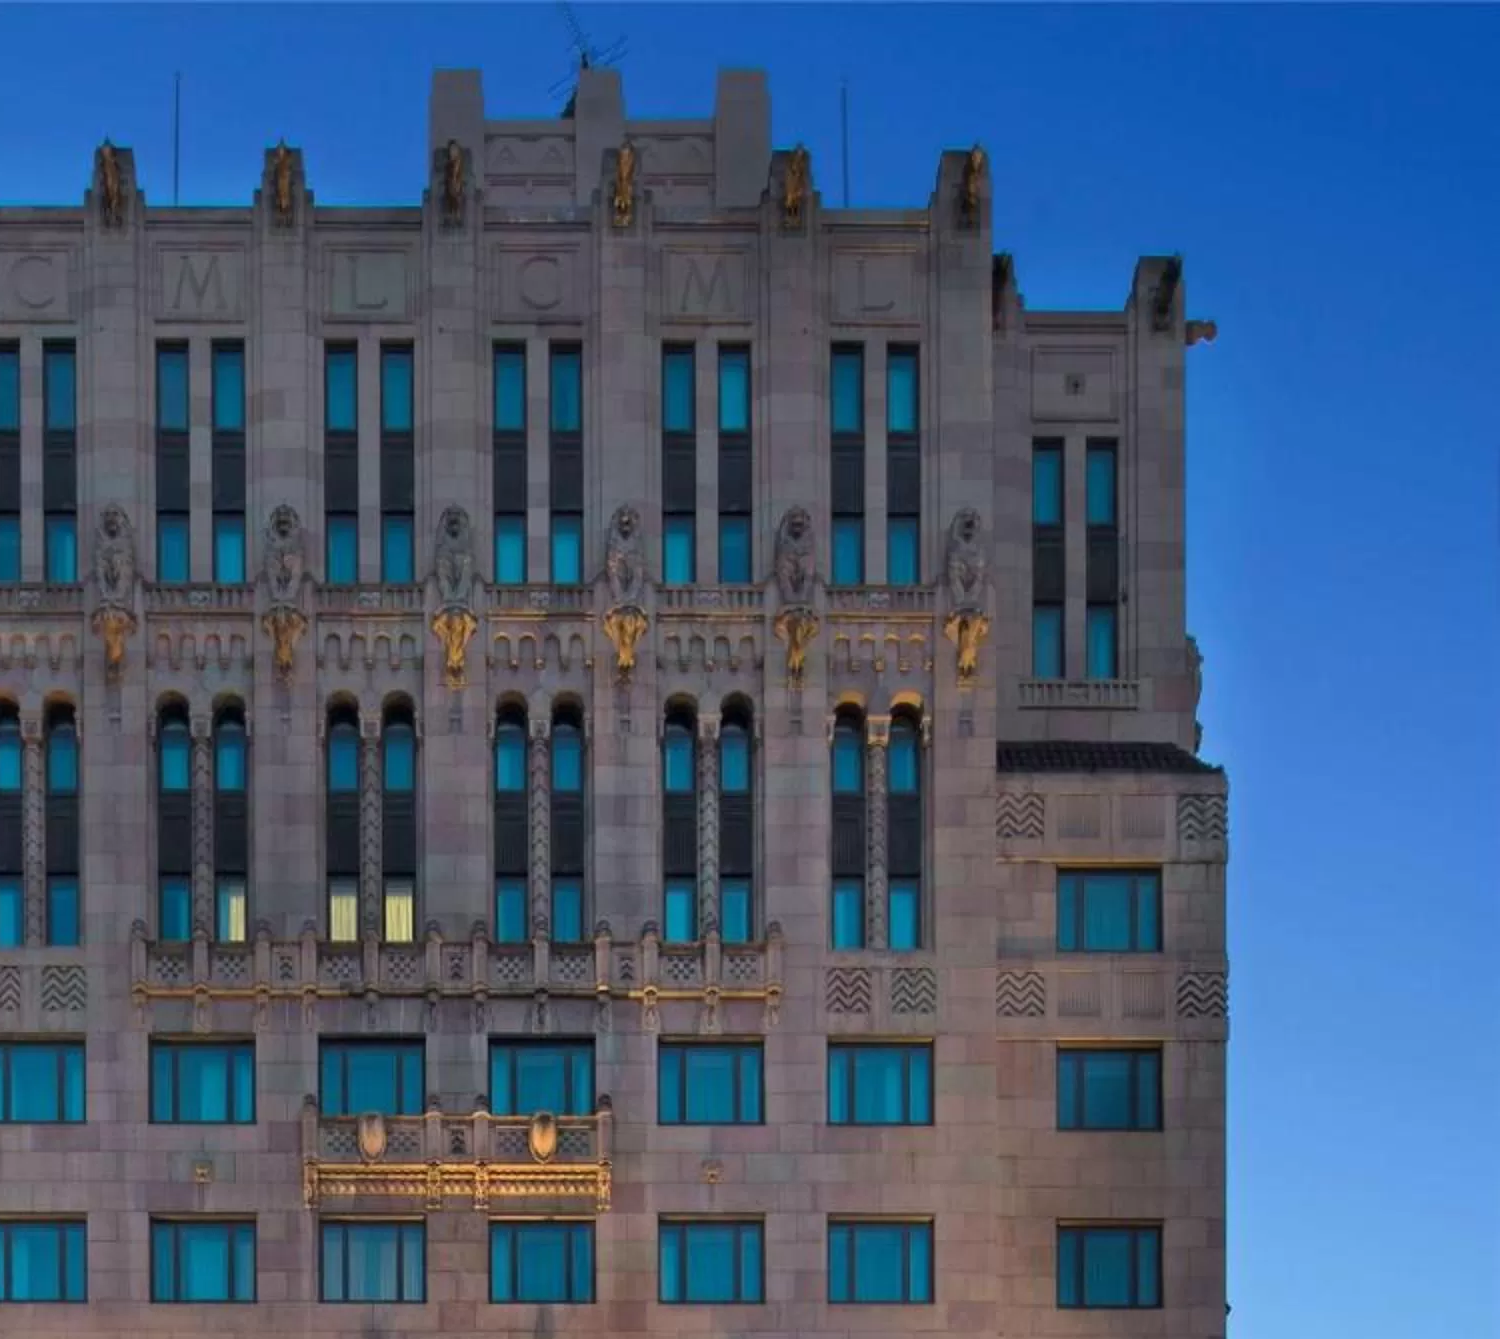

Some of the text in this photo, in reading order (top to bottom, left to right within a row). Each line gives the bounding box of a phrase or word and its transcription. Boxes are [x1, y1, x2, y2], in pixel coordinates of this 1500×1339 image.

[7, 254, 897, 312] C M L C M L
